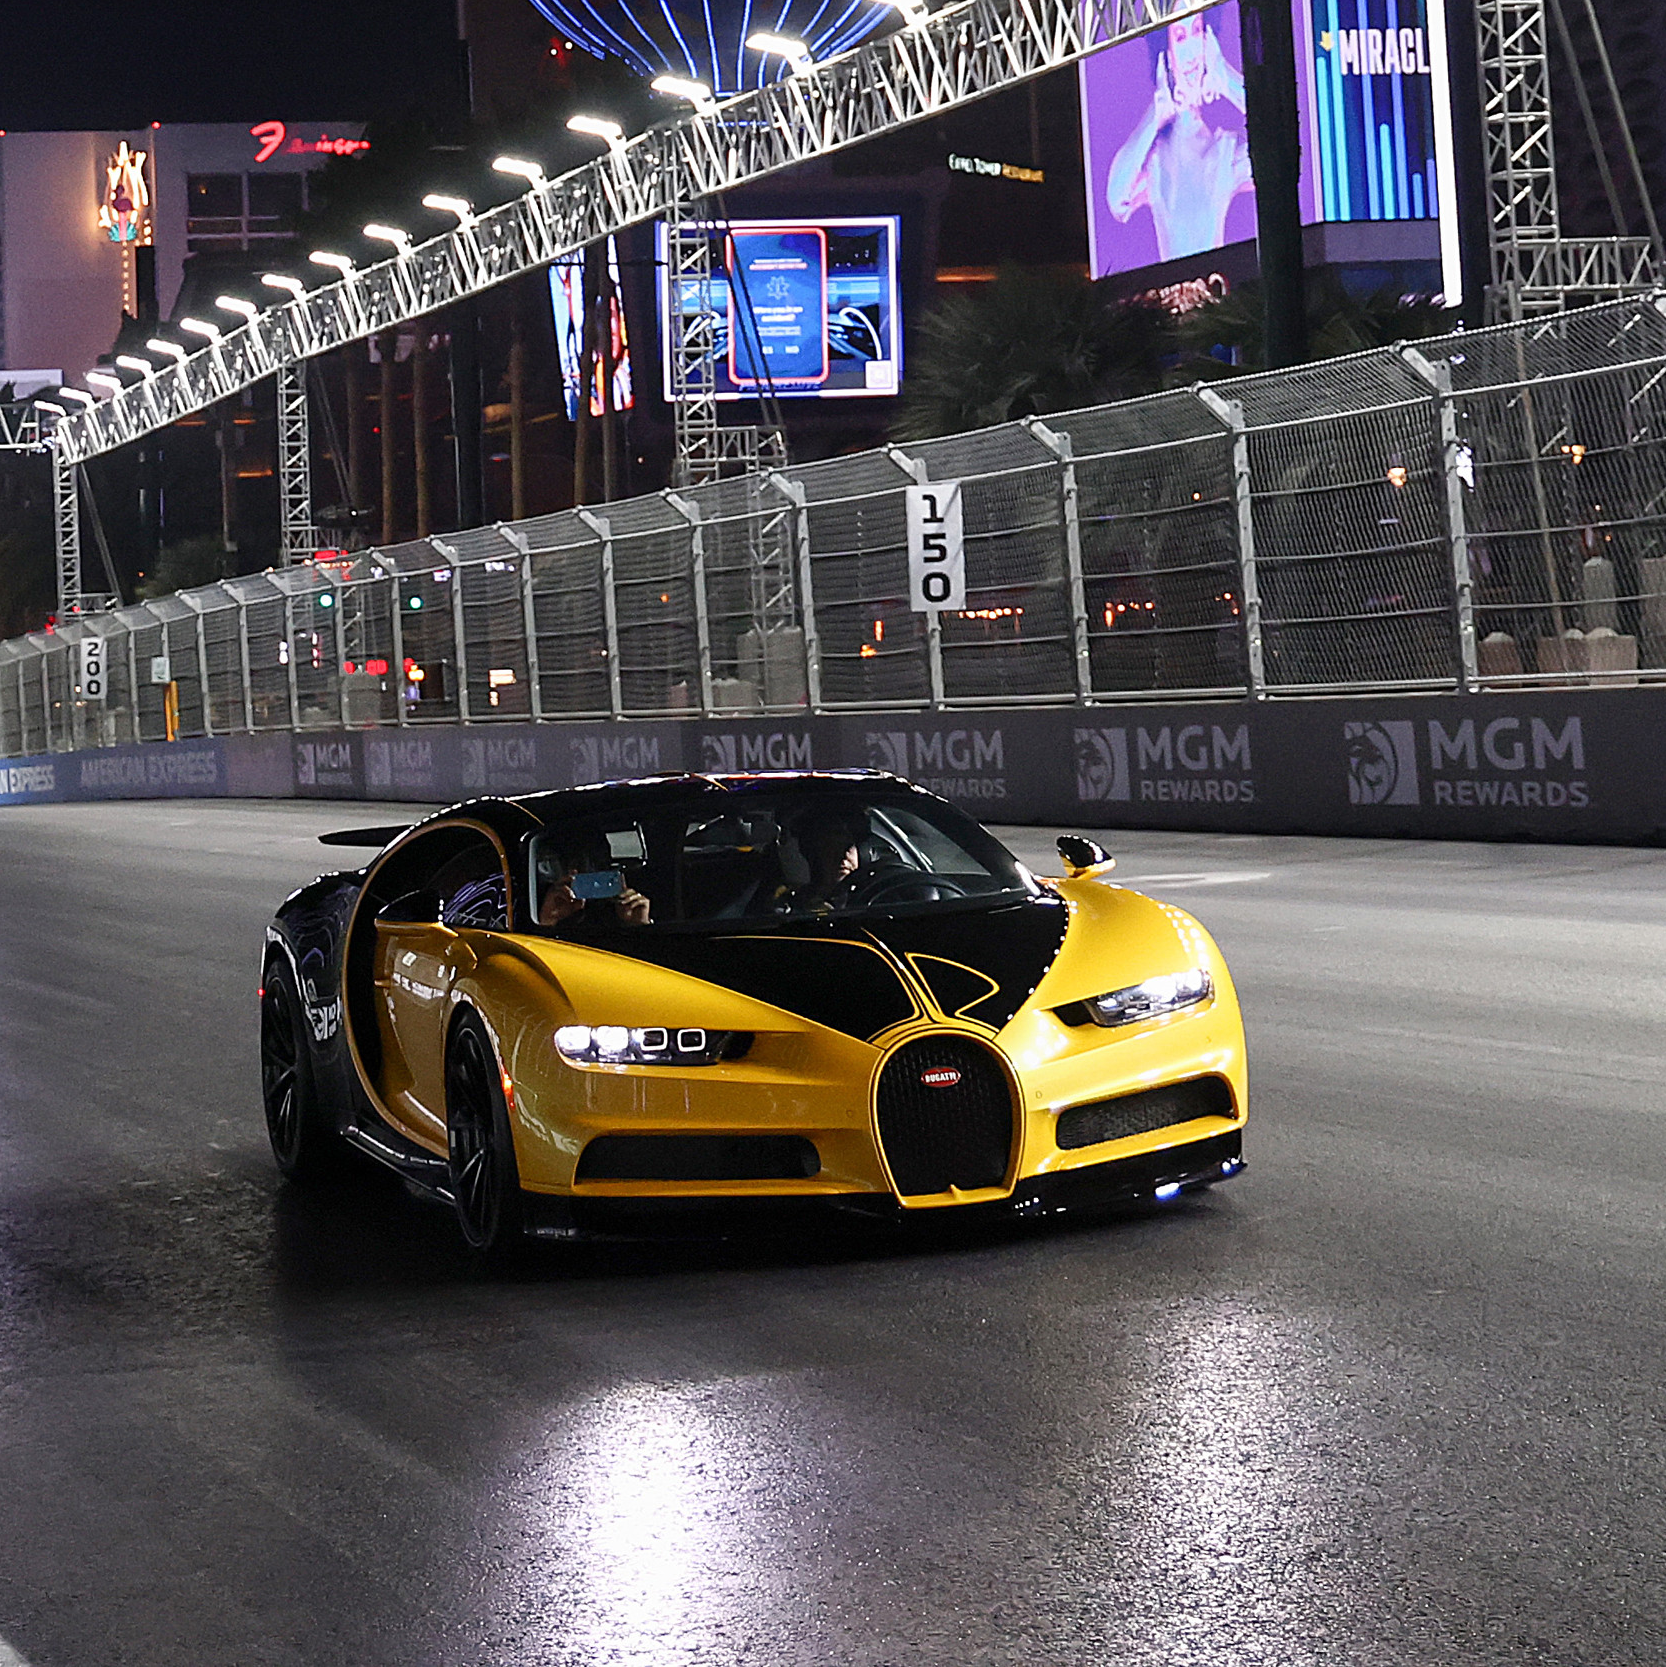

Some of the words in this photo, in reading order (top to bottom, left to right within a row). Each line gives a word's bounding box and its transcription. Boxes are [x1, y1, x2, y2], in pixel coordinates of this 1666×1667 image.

[922, 494, 951, 603] 150
[86, 641, 102, 695] 200
[602, 736, 660, 769] MGM
[741, 733, 813, 769] MGM
[915, 730, 1005, 770] MGM
[1137, 724, 1254, 771] MGM
[1428, 716, 1586, 770] MGM
[1142, 779, 1254, 803] REWARDS
[1434, 780, 1589, 808] REWARDS
[925, 1071, 957, 1083] BUGATTI
